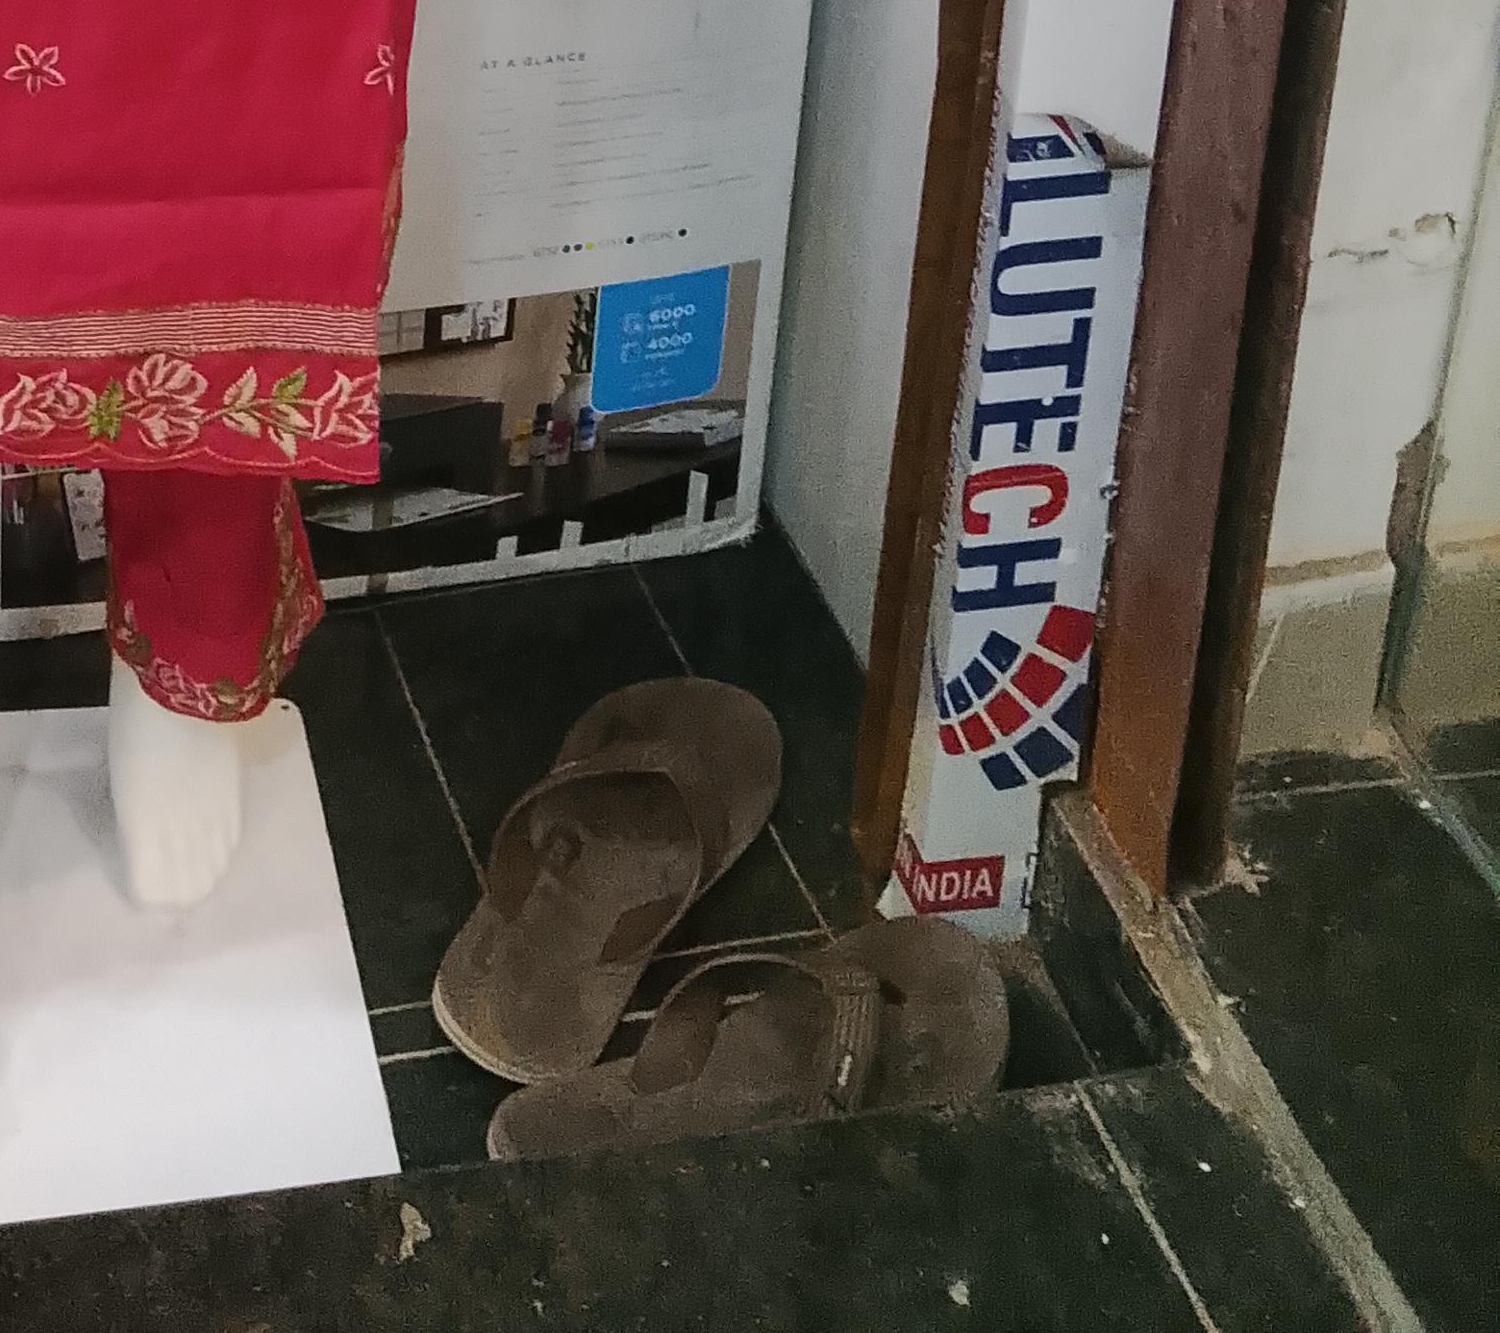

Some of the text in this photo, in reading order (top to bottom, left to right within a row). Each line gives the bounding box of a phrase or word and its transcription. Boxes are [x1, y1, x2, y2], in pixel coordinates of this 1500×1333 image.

[480, 52, 586, 70] AT A GLANCE
